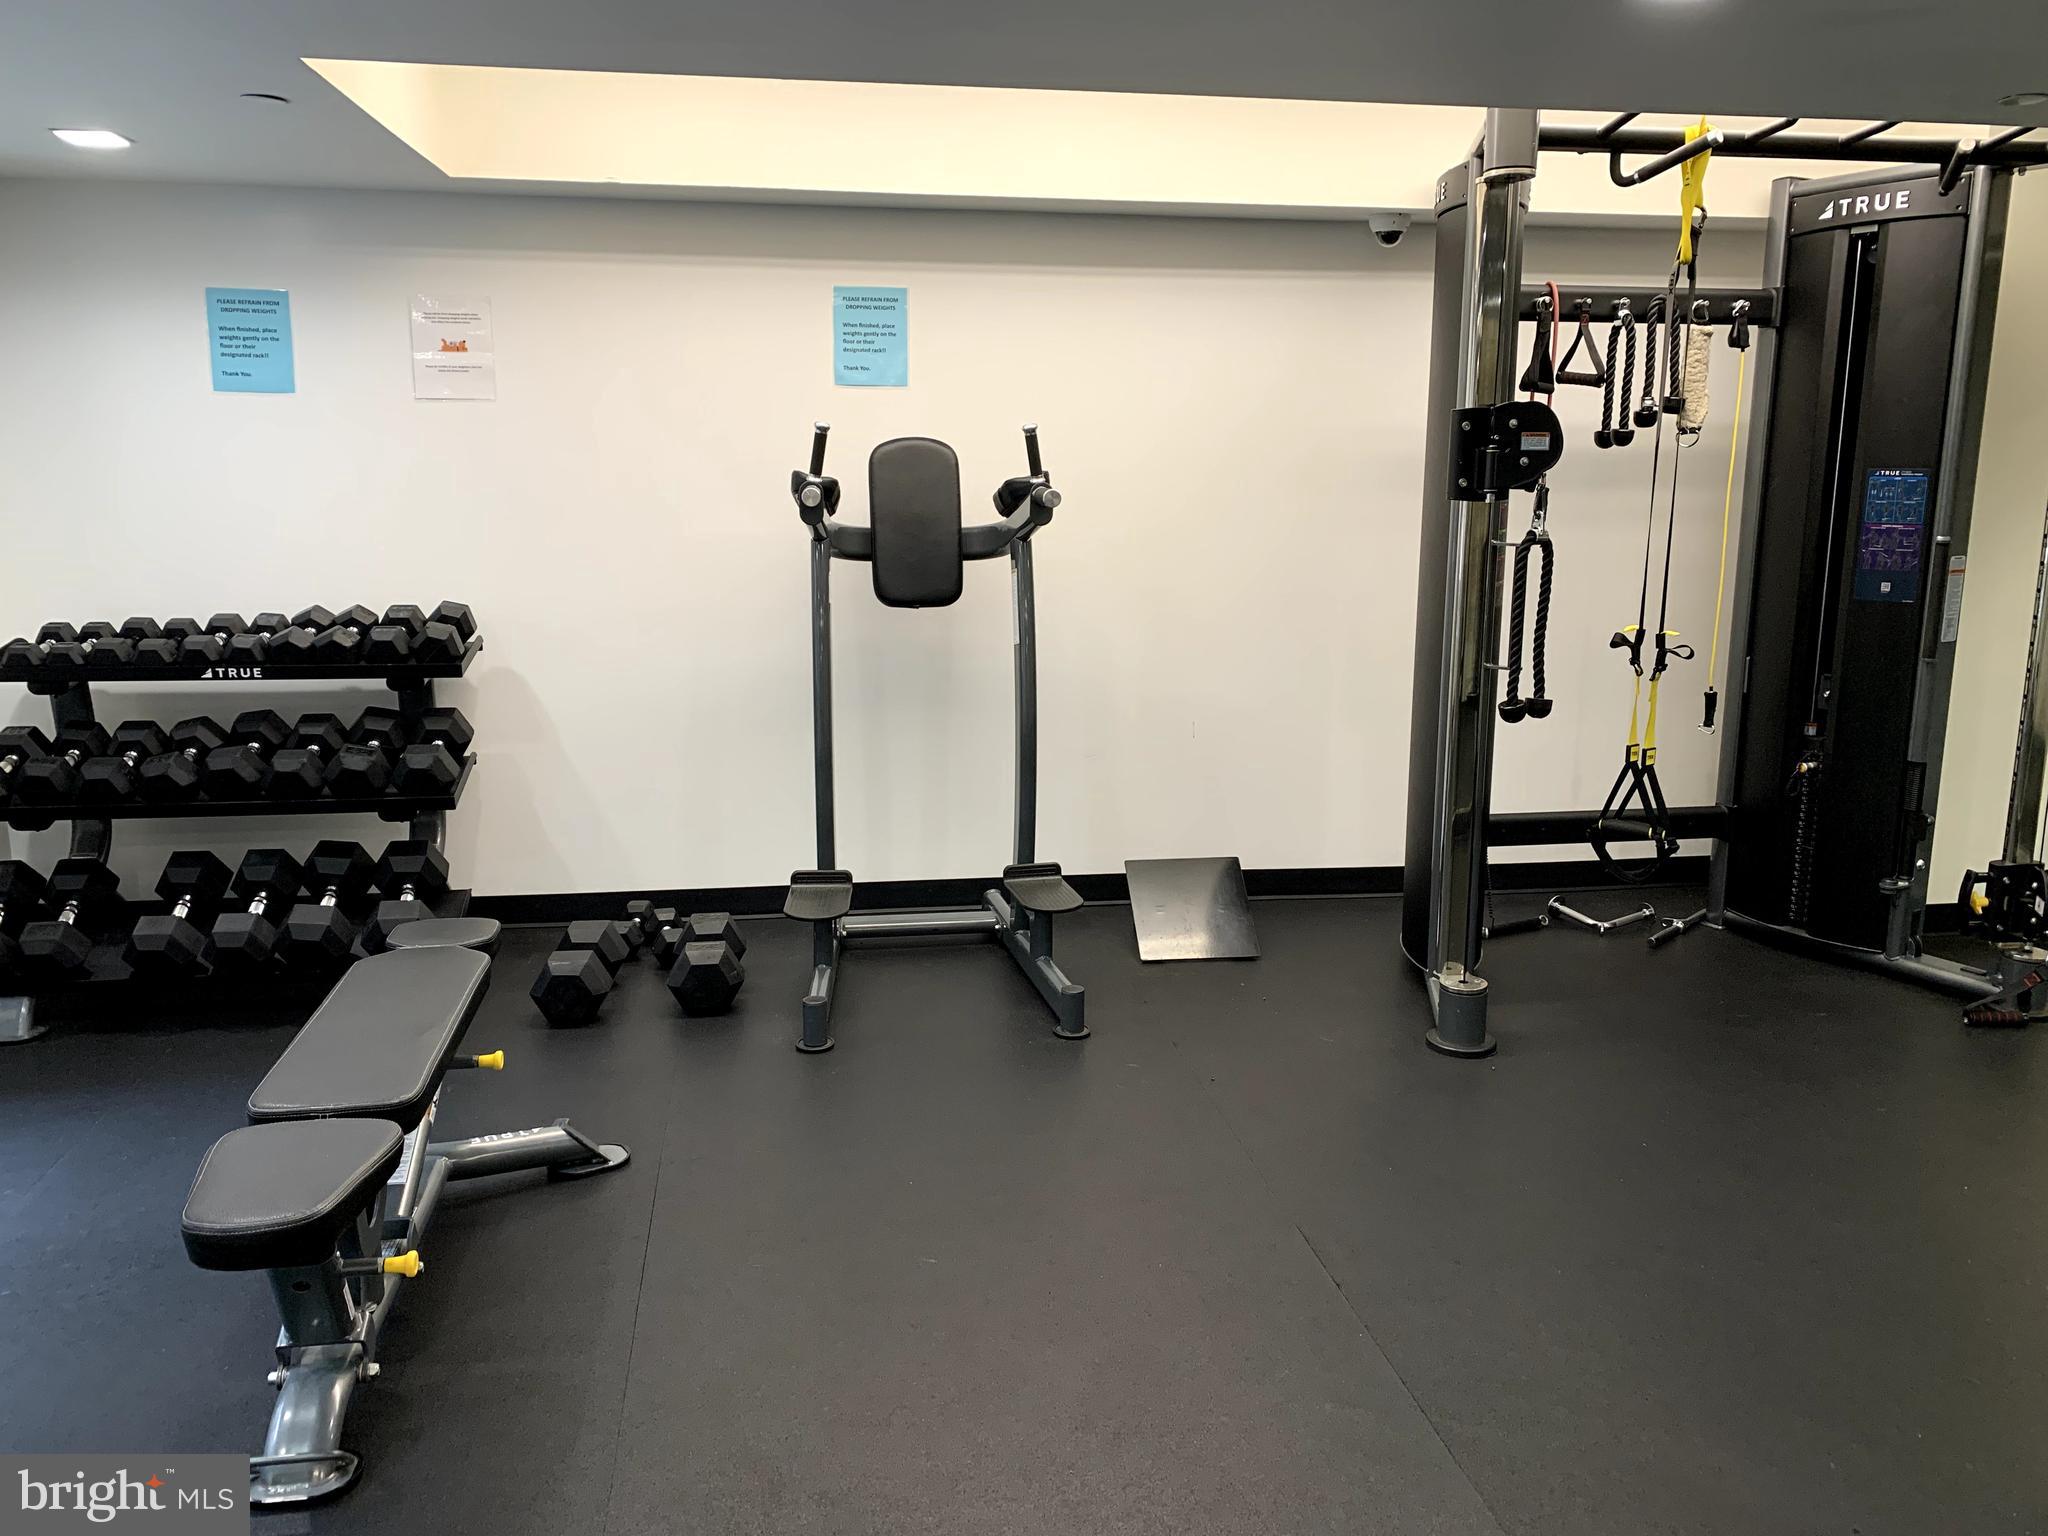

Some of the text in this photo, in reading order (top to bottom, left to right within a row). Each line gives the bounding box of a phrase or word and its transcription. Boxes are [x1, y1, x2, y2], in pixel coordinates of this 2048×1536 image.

[1838, 190, 1911, 217] TRUE
[220, 351, 252, 359] designated
[215, 667, 263, 678] TRUE
